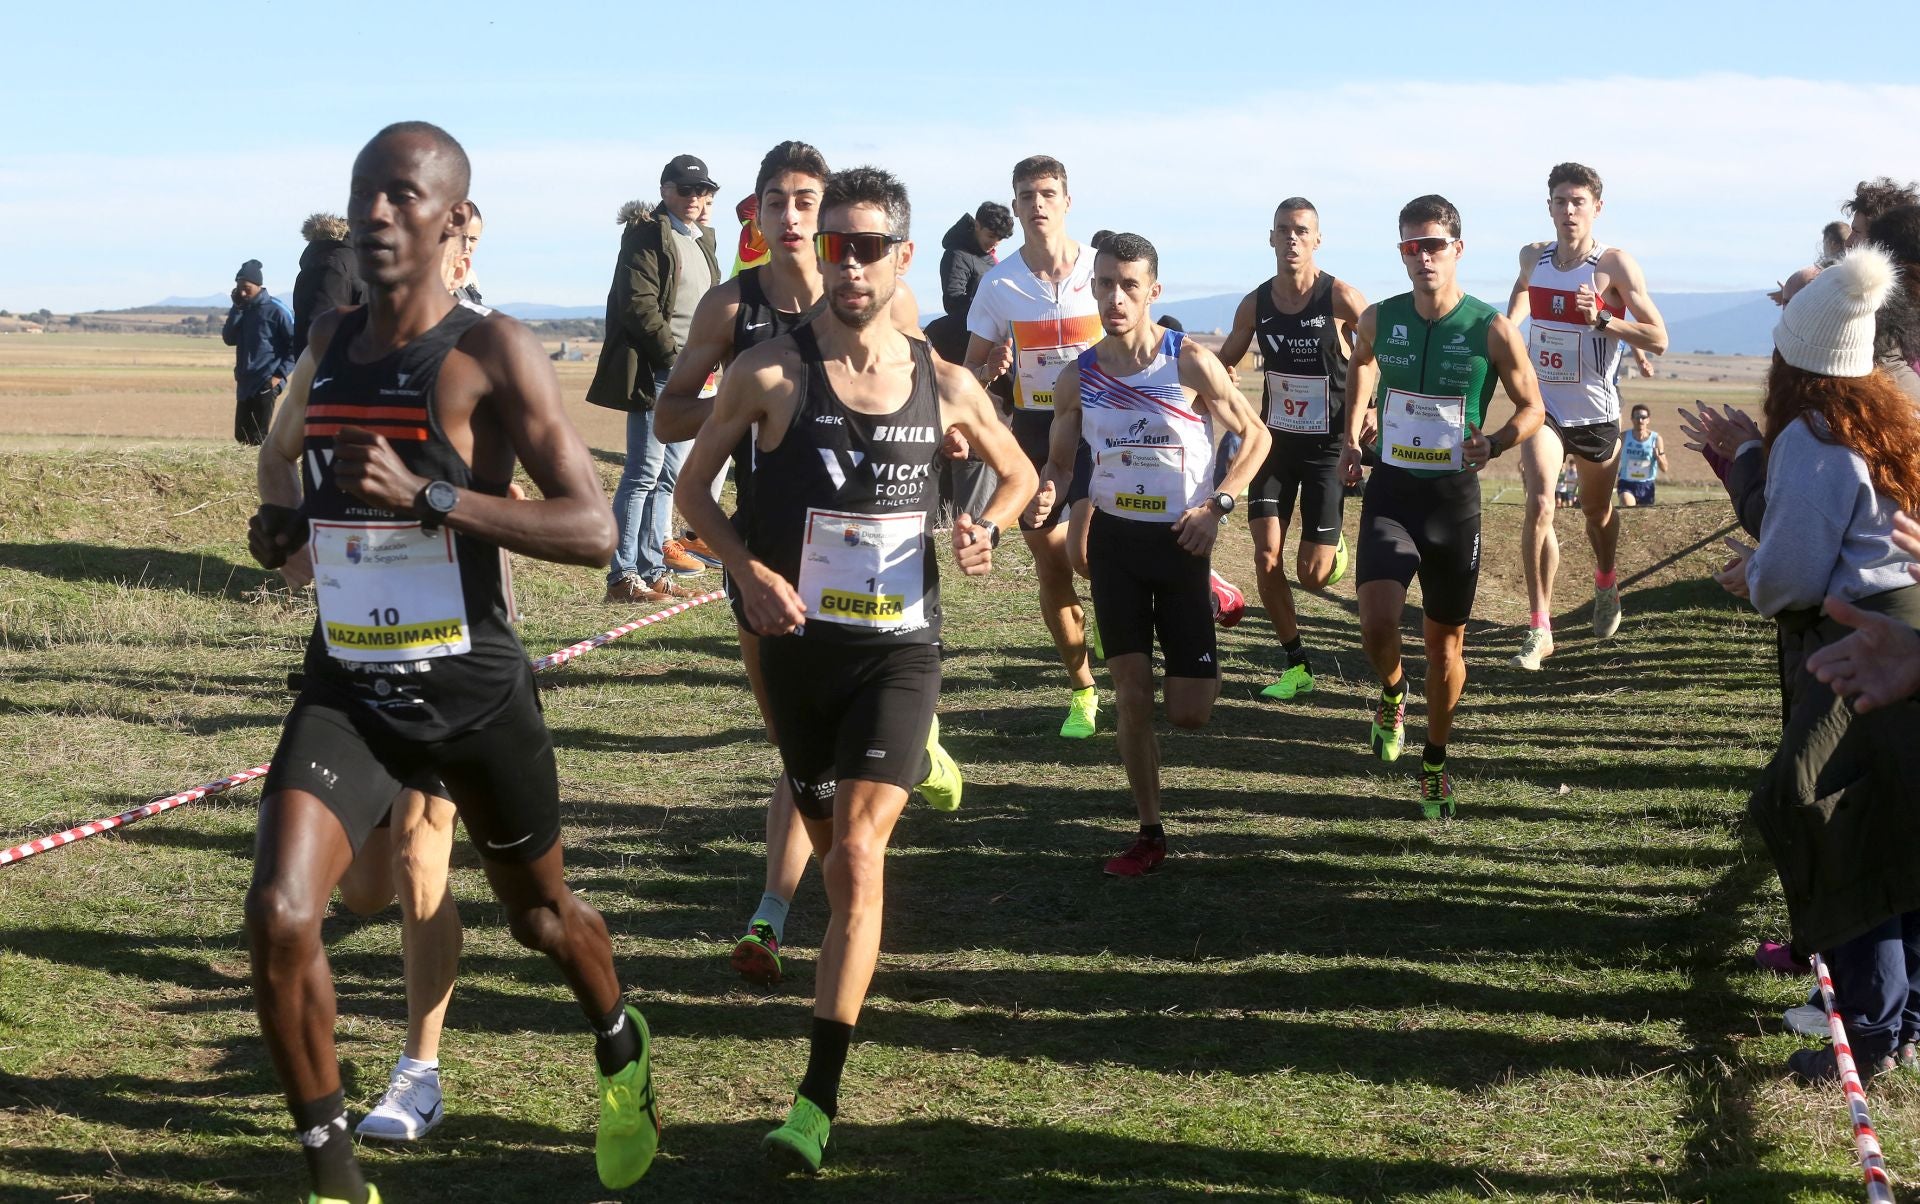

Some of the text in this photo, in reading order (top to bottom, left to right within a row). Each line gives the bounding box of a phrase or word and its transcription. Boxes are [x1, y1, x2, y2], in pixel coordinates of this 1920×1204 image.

[1287, 337, 1321, 347] VICKY
[1539, 350, 1563, 369] 56
[1283, 398, 1309, 418] 97
[872, 425, 936, 443] BIKILA
[1143, 434, 1171, 445] Run
[1412, 436, 1422, 447] 6
[1391, 446, 1452, 461] PANIAGUA
[871, 462, 931, 481] VICKY
[875, 481, 924, 497] FOODS
[1135, 484, 1145, 495] 3
[1115, 496, 1167, 510] AFERDI
[865, 577, 876, 593] 1
[821, 595, 903, 616] GUERRA
[369, 607, 400, 627] 10
[327, 624, 463, 646] NAZAMBIMANA
[364, 660, 432, 675] RUNNING
